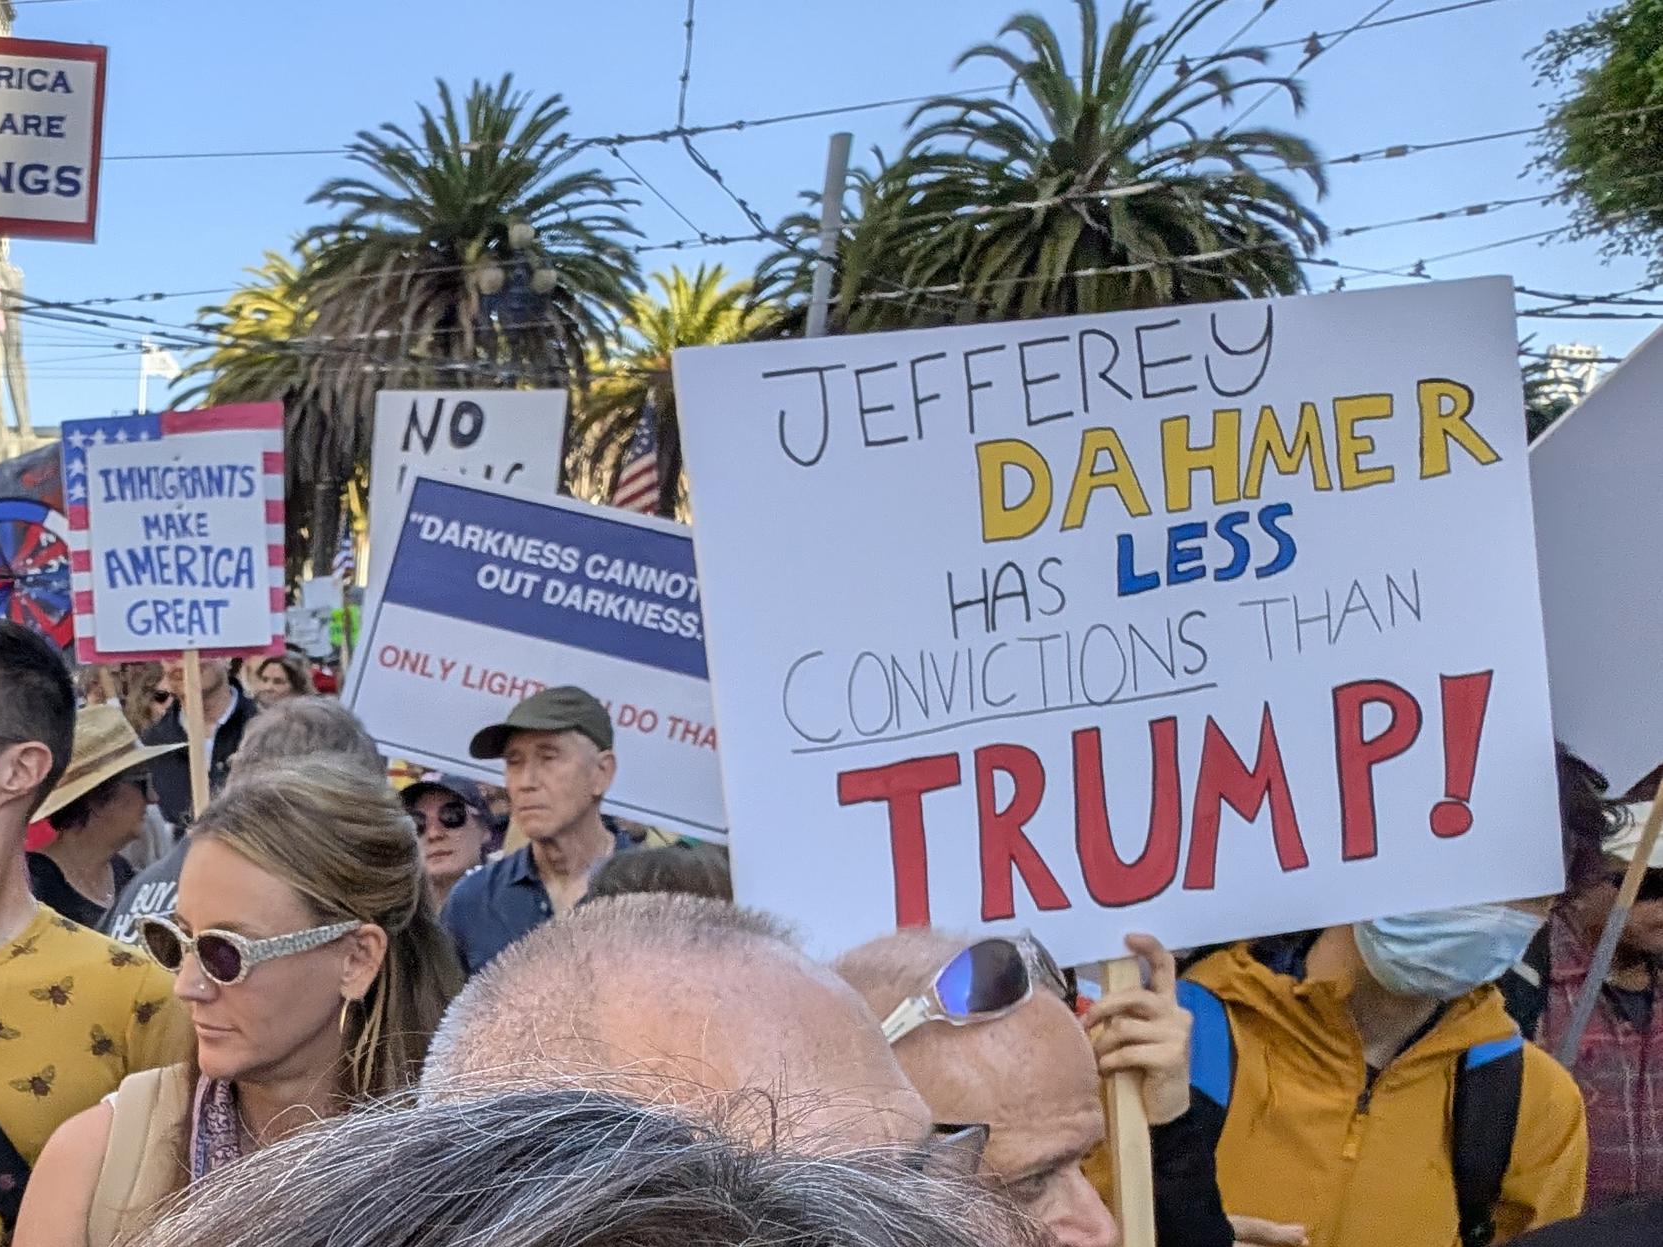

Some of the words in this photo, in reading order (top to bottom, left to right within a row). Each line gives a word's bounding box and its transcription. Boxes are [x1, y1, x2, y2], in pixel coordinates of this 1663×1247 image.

[401, 397, 484, 454] NO
[762, 305, 1274, 467] JEFFEREY
[99, 465, 255, 502] IMMIGRANTS
[974, 378, 1500, 543] DAHMER
[144, 513, 208, 540] MAKE
[105, 546, 254, 589] AMERICA
[477, 562, 541, 598] OUT
[543, 579, 703, 641] DARKNESS.
[947, 557, 1066, 638] HAS
[1116, 502, 1298, 597] LESS
[127, 599, 229, 636] GREAT
[783, 611, 1209, 744] CONVICTIONS
[1239, 569, 1421, 662] THAN
[379, 645, 454, 681] ONLY
[617, 704, 658, 733] DO
[665, 716, 716, 752] THA
[836, 668, 1494, 931] TRUMP!
[130, 881, 177, 913] BUY
